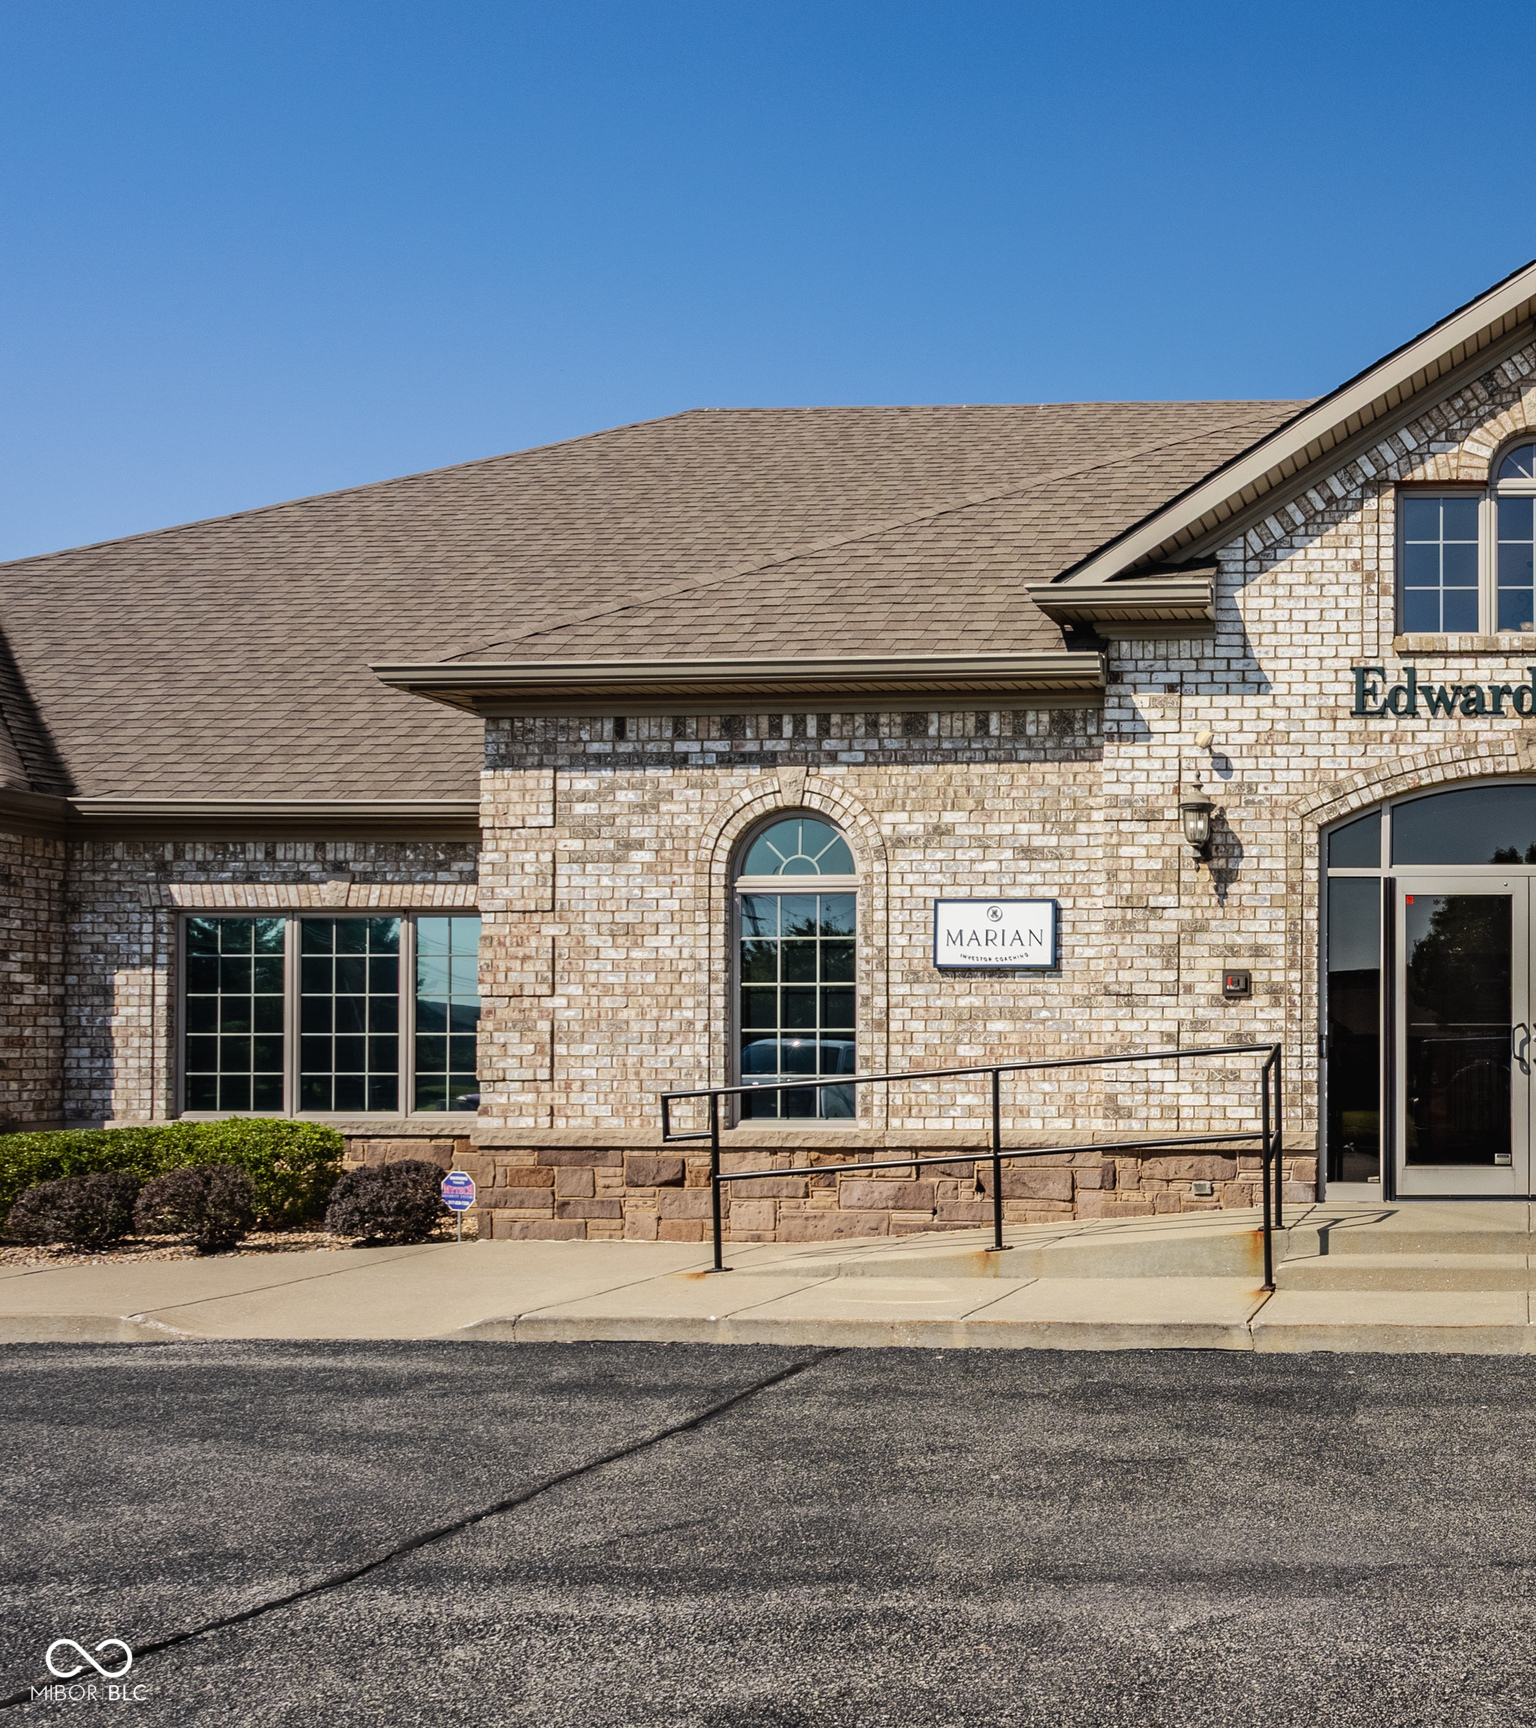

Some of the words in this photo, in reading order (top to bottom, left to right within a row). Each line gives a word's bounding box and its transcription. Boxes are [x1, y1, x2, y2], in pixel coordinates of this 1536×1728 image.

[946, 929, 1044, 947] MARIAN
[960, 953, 992, 962] INVESTOR
[995, 952, 1029, 962] COACHING
